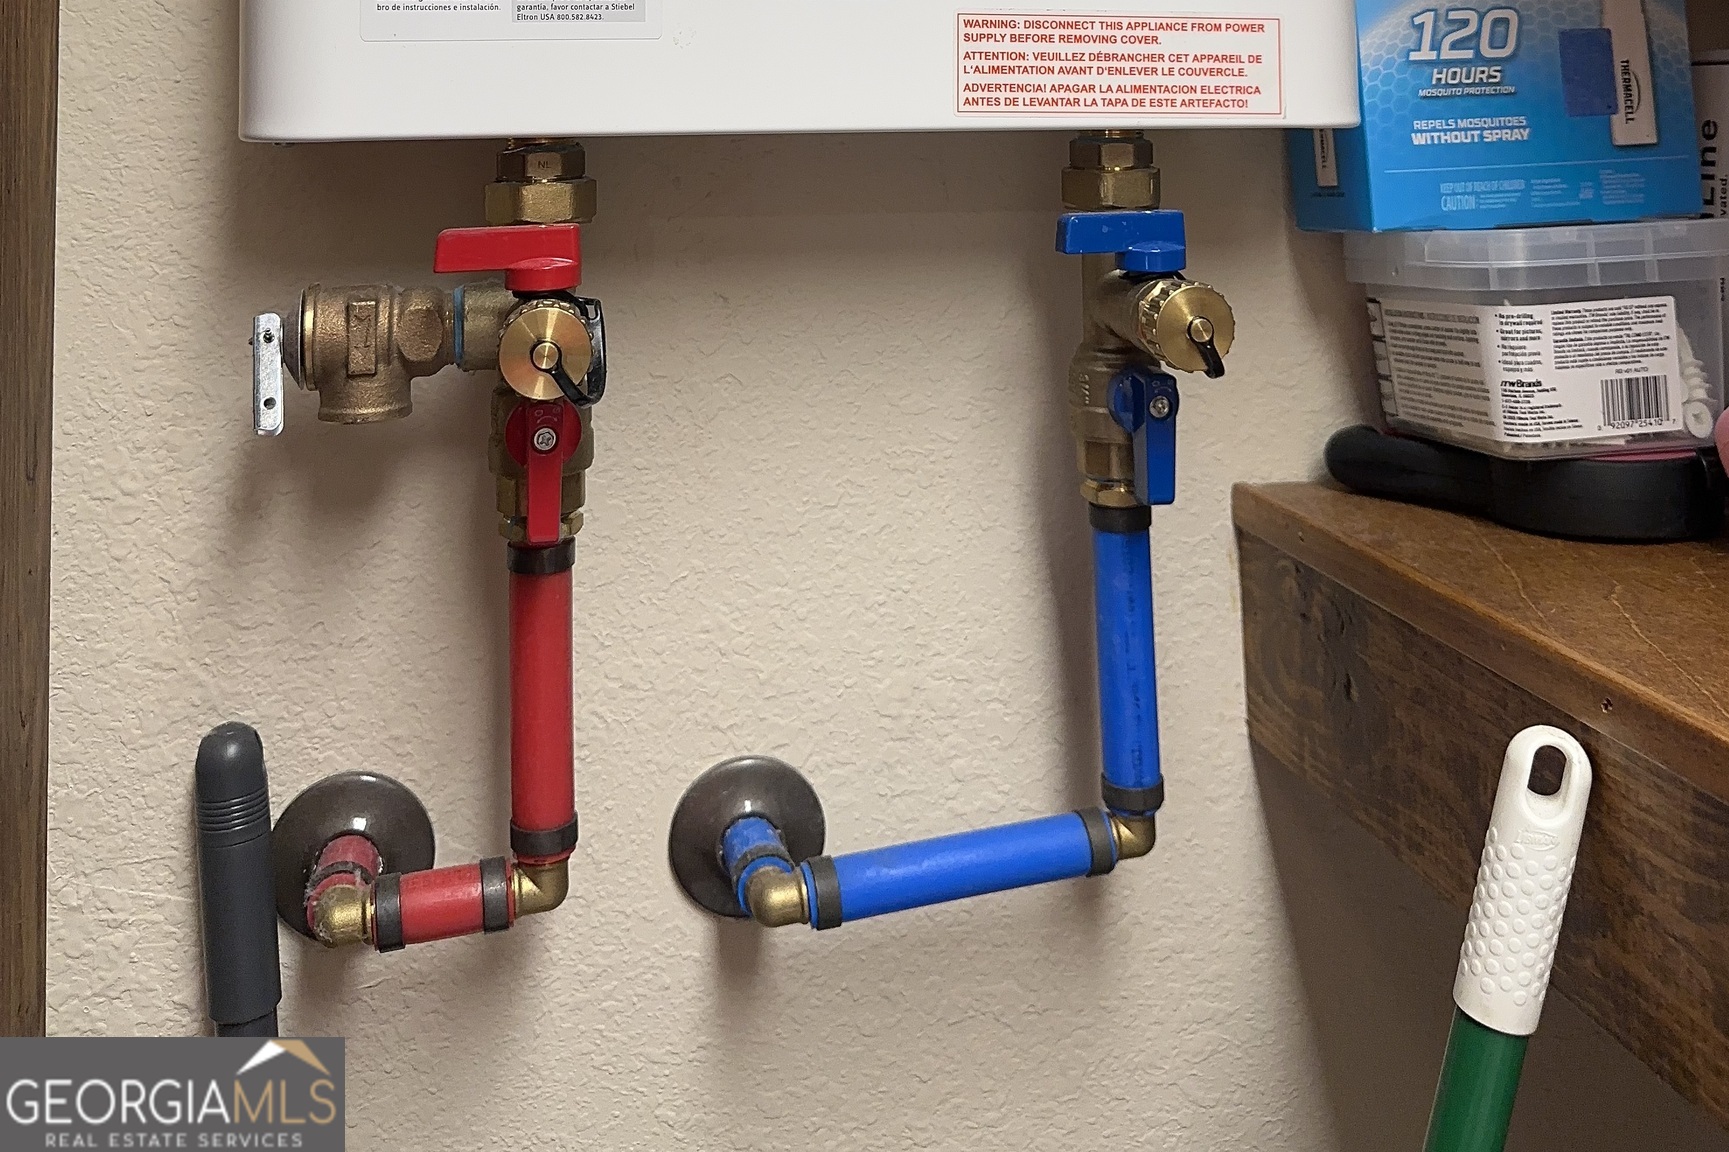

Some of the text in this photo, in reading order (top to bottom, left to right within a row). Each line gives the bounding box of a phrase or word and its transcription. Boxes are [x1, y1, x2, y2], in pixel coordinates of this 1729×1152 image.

[963, 18, 1264, 33] WARNING: DISCONNECT THIS APPLIANCE FROM POWER
[963, 32, 1161, 45] SUPPLY BEFORE REMOVING COVER.
[1408, 8, 1518, 60] 120
[962, 51, 1262, 64] ATTENTION: VEUILLEZ DÉBRANCHER CET APPAREIL DE
[1057, 65, 1093, 75] AVANT
[1161, 66, 1175, 76] LE
[1177, 67, 1248, 77] COUVERCLE.
[1432, 66, 1502, 84] HOURS
[962, 82, 1261, 95] ADVERTENCIA! APAGAR LA ALIMENTACION ELECTRICA
[1418, 86, 1515, 96] MOSQUITO PROTECTION
[1620, 58, 1636, 124] THERMACELL
[962, 96, 1248, 108] ANTES DE LEVANTAR LA TAPA DE ESTE ARTEFACTO!
[1414, 116, 1526, 130] REPELS MOSQUITOES
[1411, 128, 1530, 145] WITHOUT SPRAY
[1441, 195, 1476, 211] CAUTION
